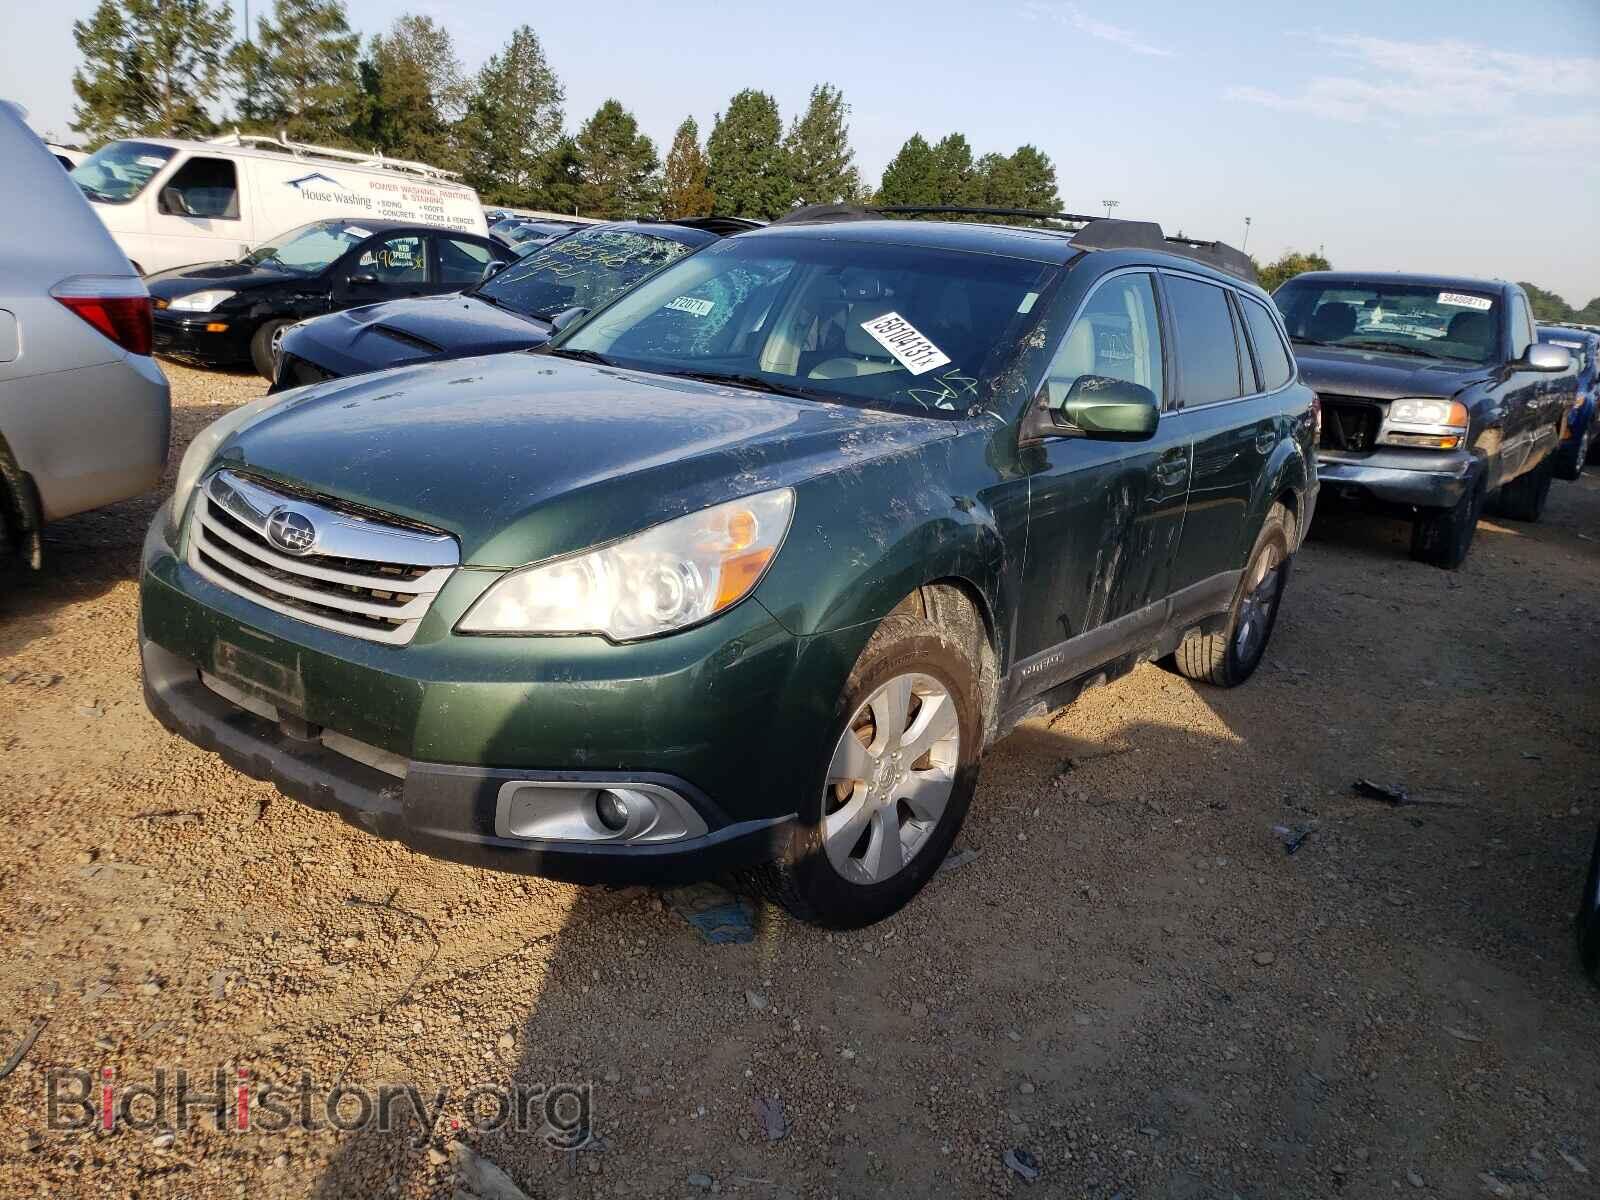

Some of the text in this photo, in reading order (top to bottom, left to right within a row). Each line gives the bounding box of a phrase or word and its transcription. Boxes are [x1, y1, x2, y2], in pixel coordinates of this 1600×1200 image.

[369, 182, 399, 192] POWER
[301, 187, 373, 210] House Washing
